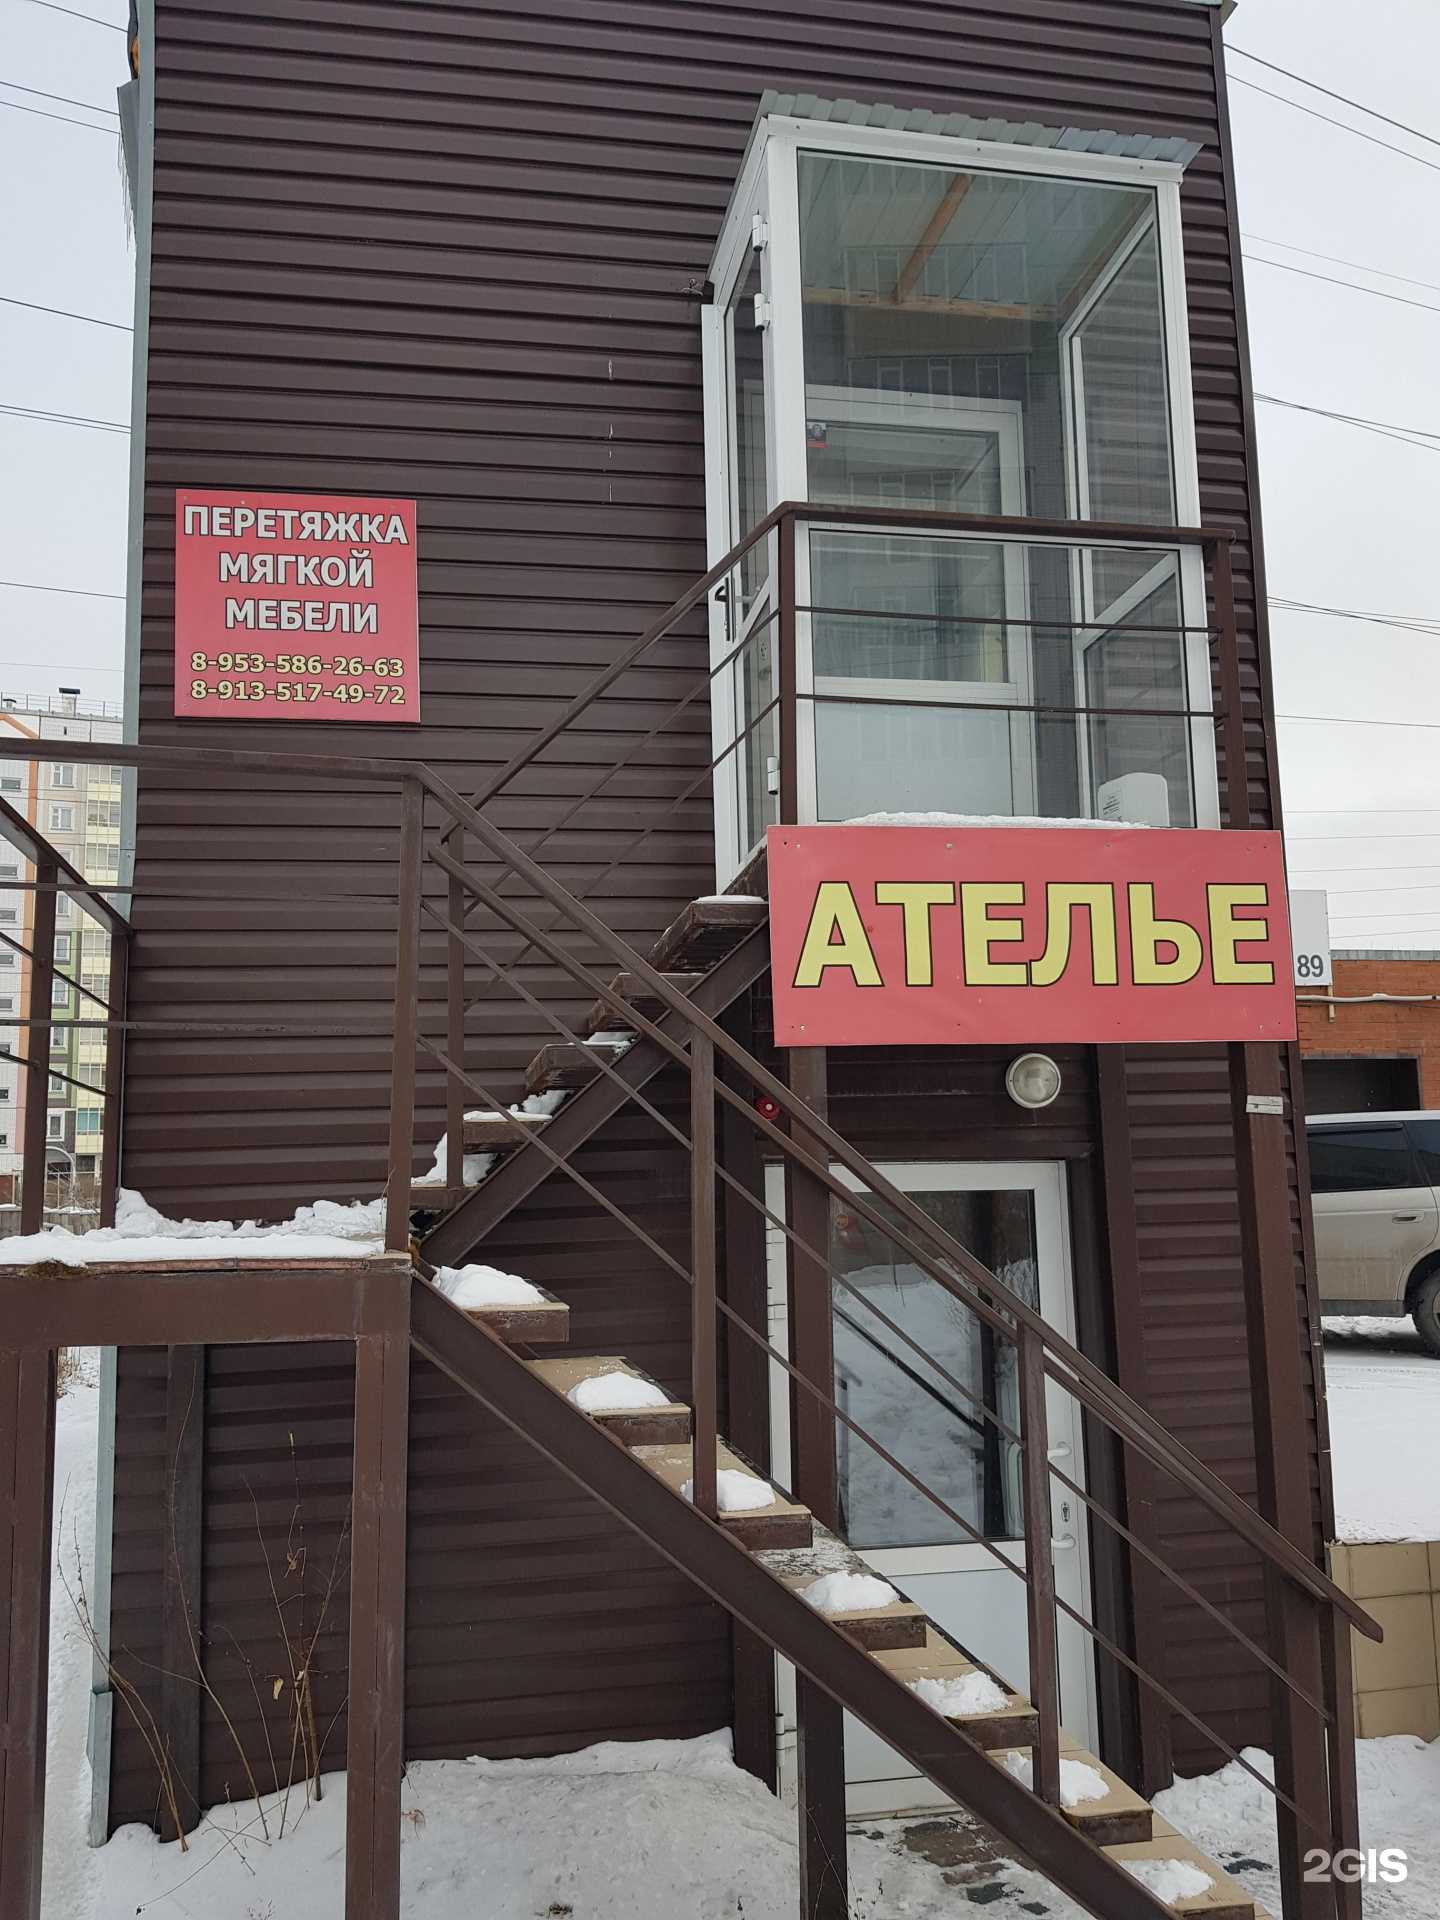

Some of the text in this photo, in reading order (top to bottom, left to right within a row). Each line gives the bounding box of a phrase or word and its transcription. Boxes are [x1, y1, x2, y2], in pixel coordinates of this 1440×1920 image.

[184, 505, 409, 545] ПЕРЕТЯЖКА
[219, 549, 374, 588] МЯГКОЙ
[225, 598, 378, 633] МЕБЕЛИ
[191, 652, 404, 677] 8-953-586-26-63
[191, 679, 405, 704] 8-913-517-49-72
[792, 881, 1275, 987] АТЕЛЬЕ
[1297, 954, 1324, 978] 89
